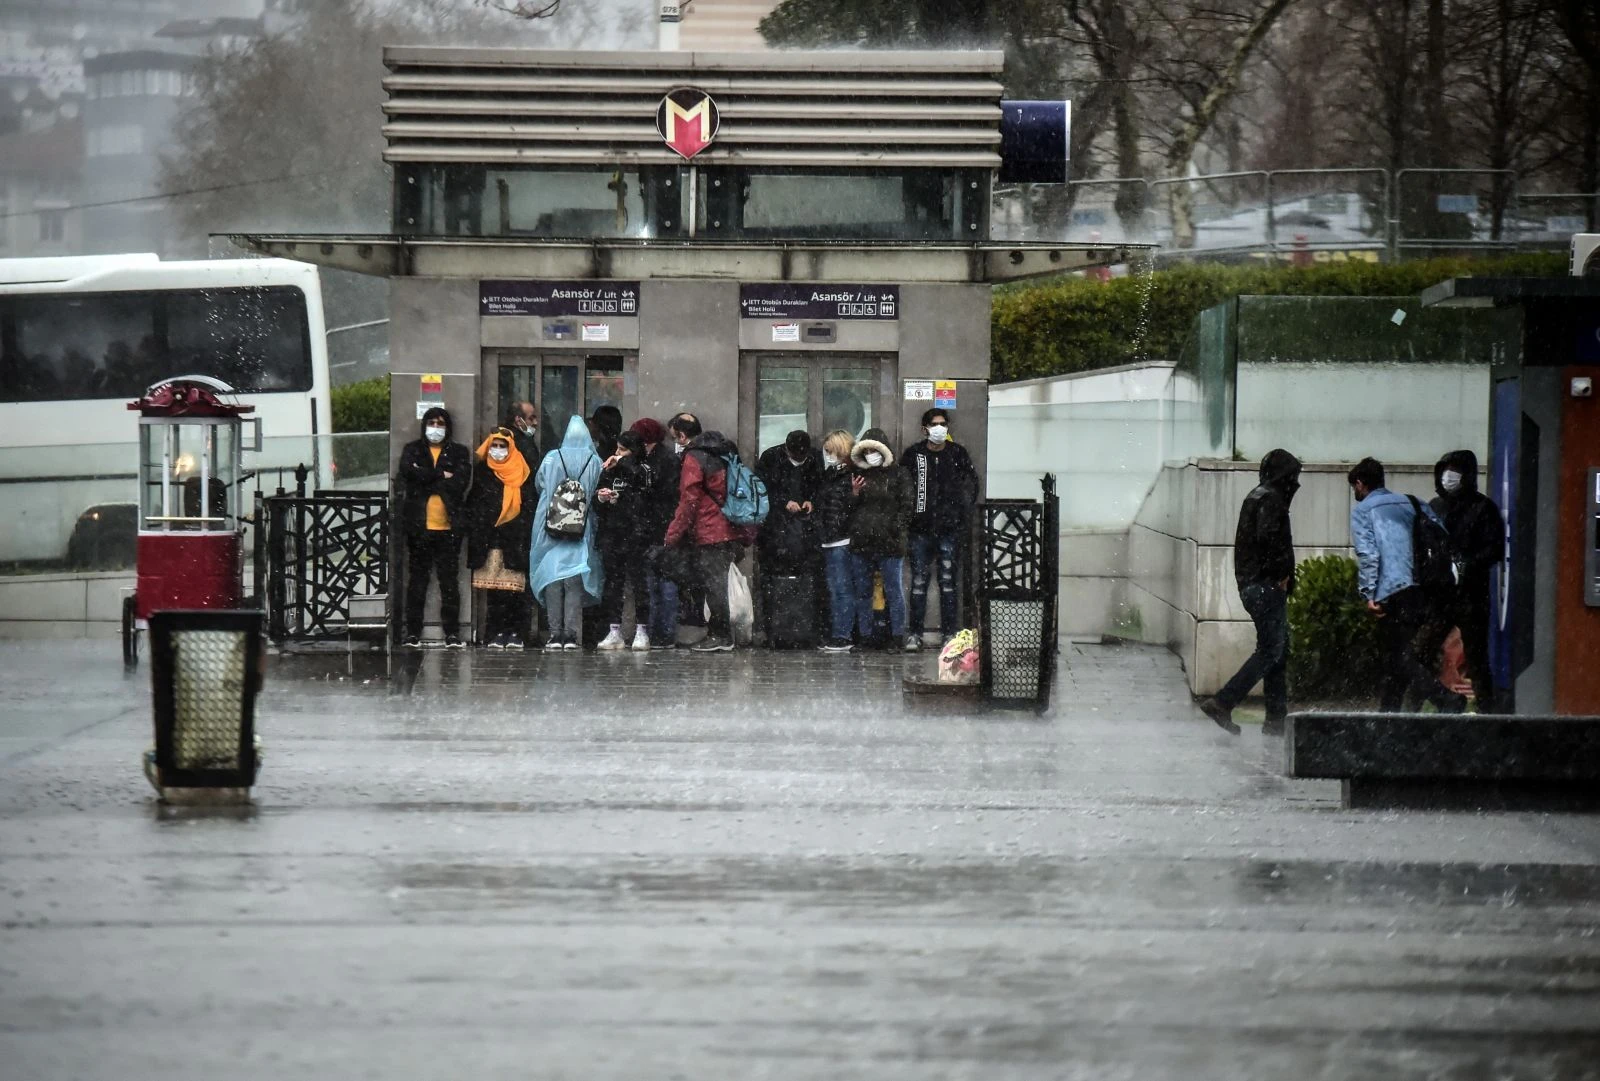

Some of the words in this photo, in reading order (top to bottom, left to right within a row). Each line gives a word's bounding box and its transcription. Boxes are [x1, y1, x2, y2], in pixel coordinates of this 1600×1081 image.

[666, 95, 710, 142] M
[552, 288, 594, 299] Asansör
[605, 291, 617, 299] Lift
[811, 292, 854, 302] Asansör
